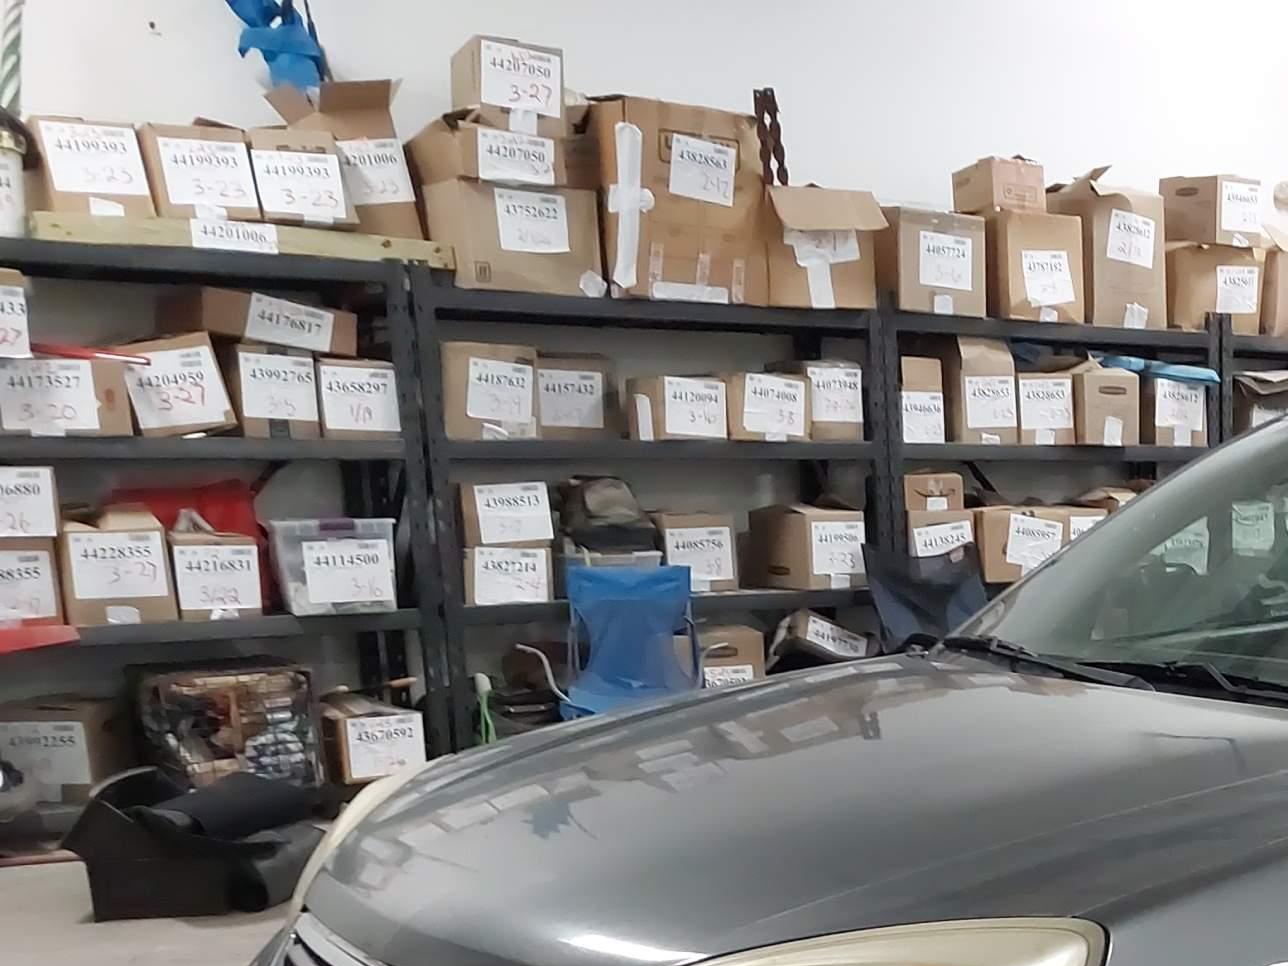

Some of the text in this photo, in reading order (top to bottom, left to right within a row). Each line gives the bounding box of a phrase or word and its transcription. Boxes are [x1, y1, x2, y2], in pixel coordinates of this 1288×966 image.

[490, 57, 551, 79] 44207050
[55, 137, 128, 153] 44199393
[170, 154, 239, 169] 44199393
[486, 144, 545, 163] 44207050
[263, 164, 330, 180] 44199393
[201, 224, 268, 244] 44201006
[257, 308, 323, 334] 44176817
[325, 381, 388, 396] 43658297
[80, 546, 152, 560] 44228355
[313, 552, 380, 568] 44114500
[185, 558, 252, 573] 44216831
